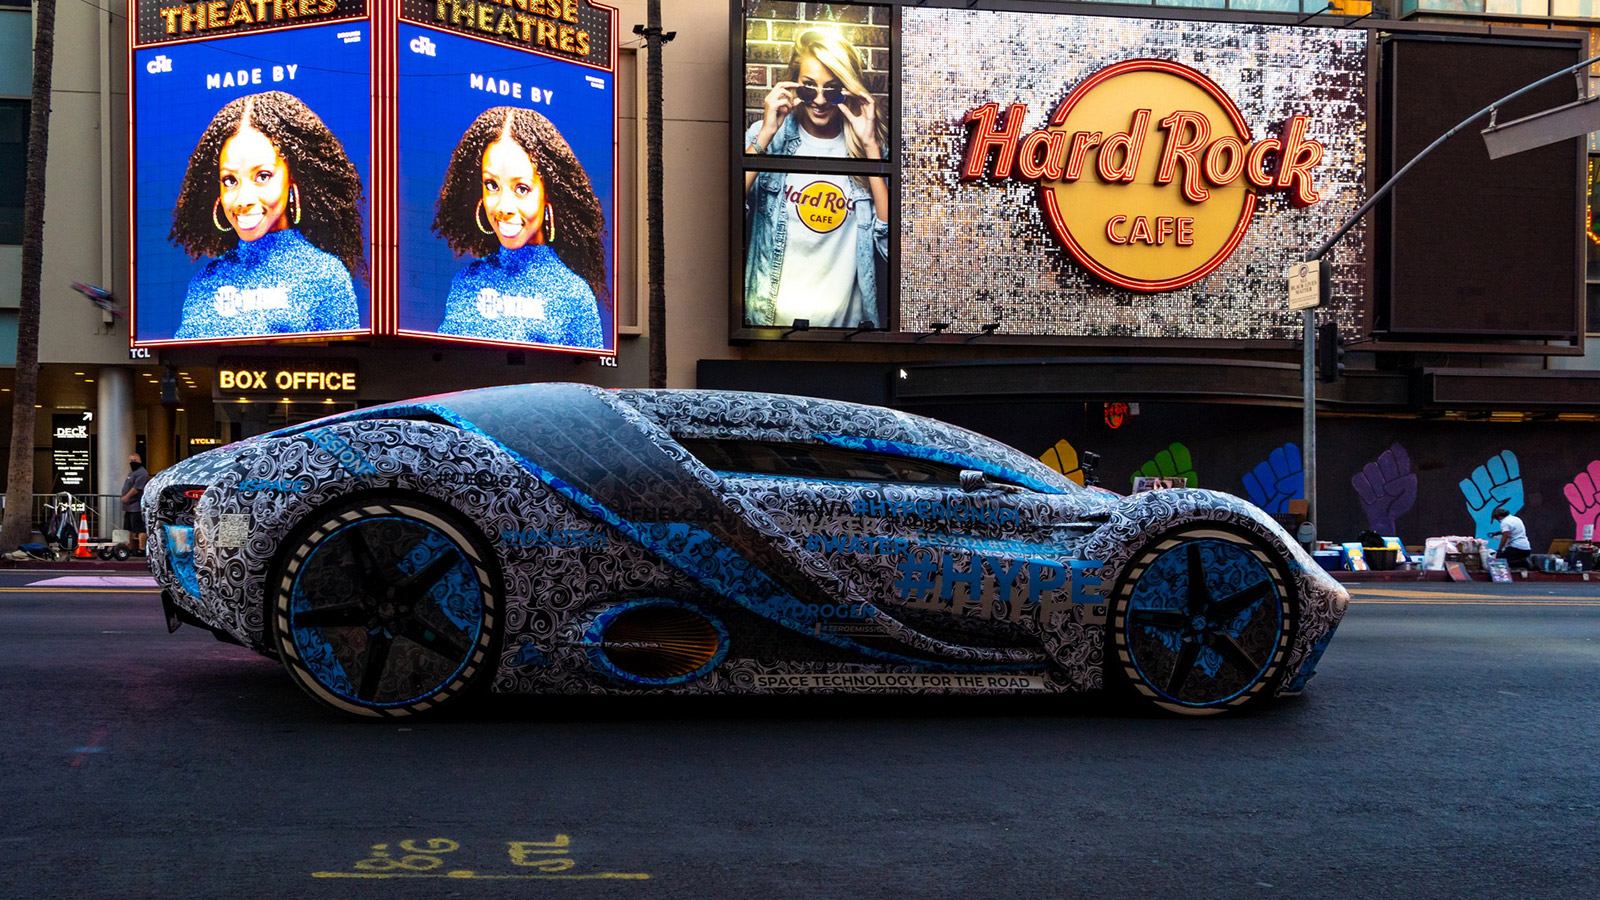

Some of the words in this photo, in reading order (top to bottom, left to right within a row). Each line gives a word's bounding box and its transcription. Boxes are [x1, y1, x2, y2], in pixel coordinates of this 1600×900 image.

[436, 0, 591, 56] THEATRES
[207, 68, 262, 90] MADE
[272, 64, 298, 82] BY
[470, 73, 523, 99] MADE
[531, 86, 554, 105] BY
[961, 102, 1152, 183] Hard
[1154, 108, 1326, 207] Rock
[823, 191, 855, 214] Roc
[810, 213, 833, 225] CAFE
[1105, 214, 1196, 247] CAFE
[130, 348, 151, 359] TCL
[600, 356, 618, 367] TCL
[219, 370, 268, 390] BOX
[275, 371, 357, 391] OFFICE
[238, 479, 305, 492] #SPACE
[501, 529, 607, 545] #NASATECH
[805, 534, 910, 555] #WATER
[895, 553, 1105, 604] #HYPE
[757, 675, 809, 687] SPACE
[812, 675, 917, 687] TECHNOLOGY
[921, 675, 952, 687] FOR
[954, 675, 984, 688] THE
[987, 676, 1030, 689] ROAD
